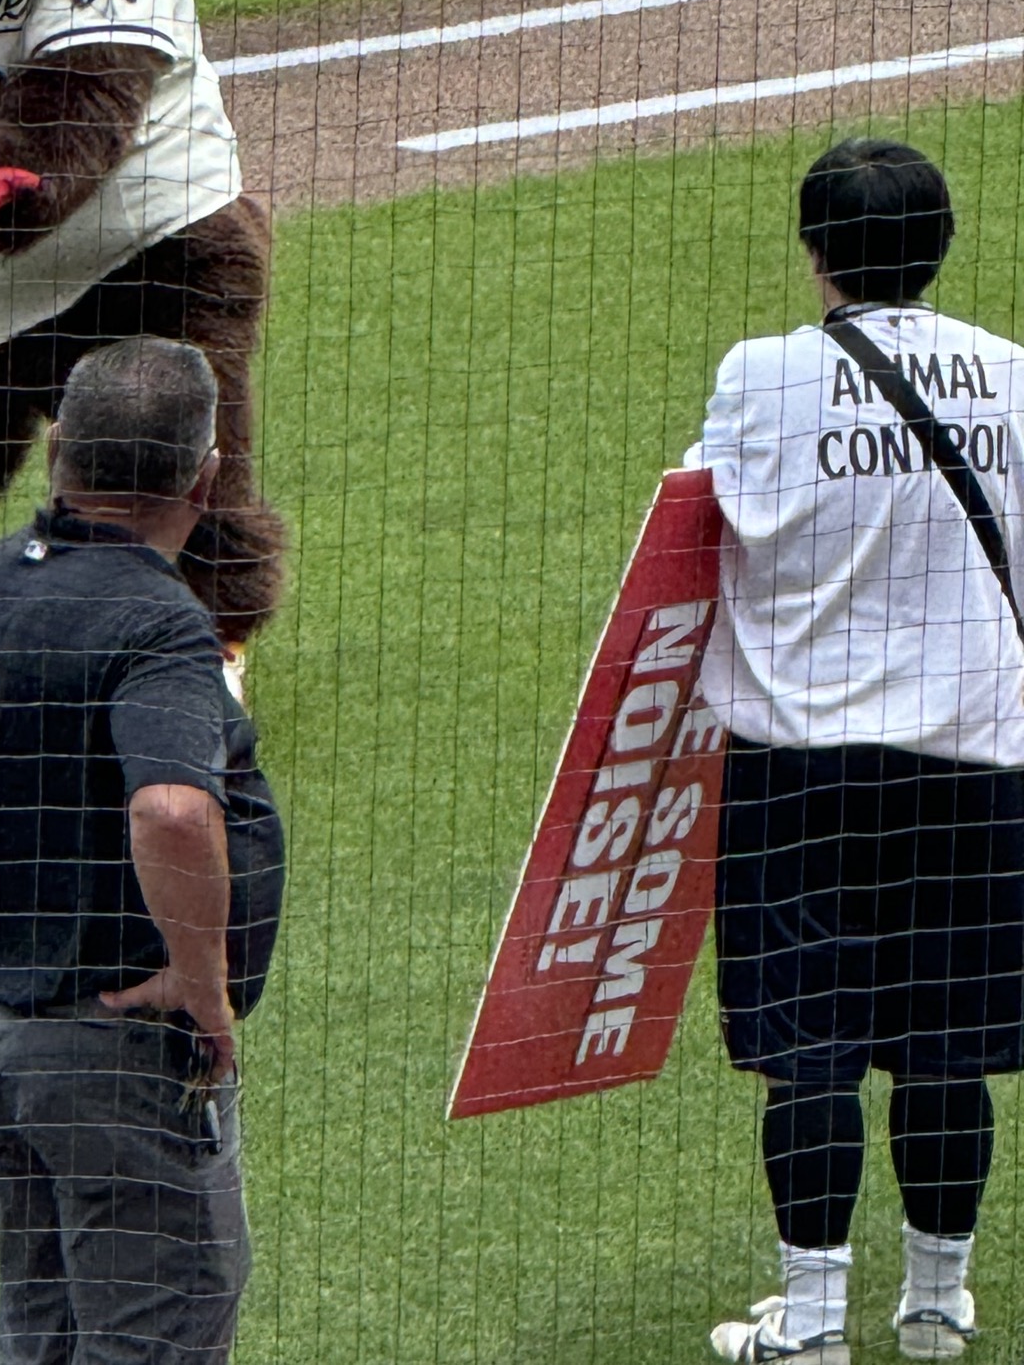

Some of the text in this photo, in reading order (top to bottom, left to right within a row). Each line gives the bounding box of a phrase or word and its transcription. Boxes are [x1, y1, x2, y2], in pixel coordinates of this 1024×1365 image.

[832, 352, 997, 407] AMAL
[536, 600, 712, 972] NOISE!
[576, 782, 703, 1067] SOME
